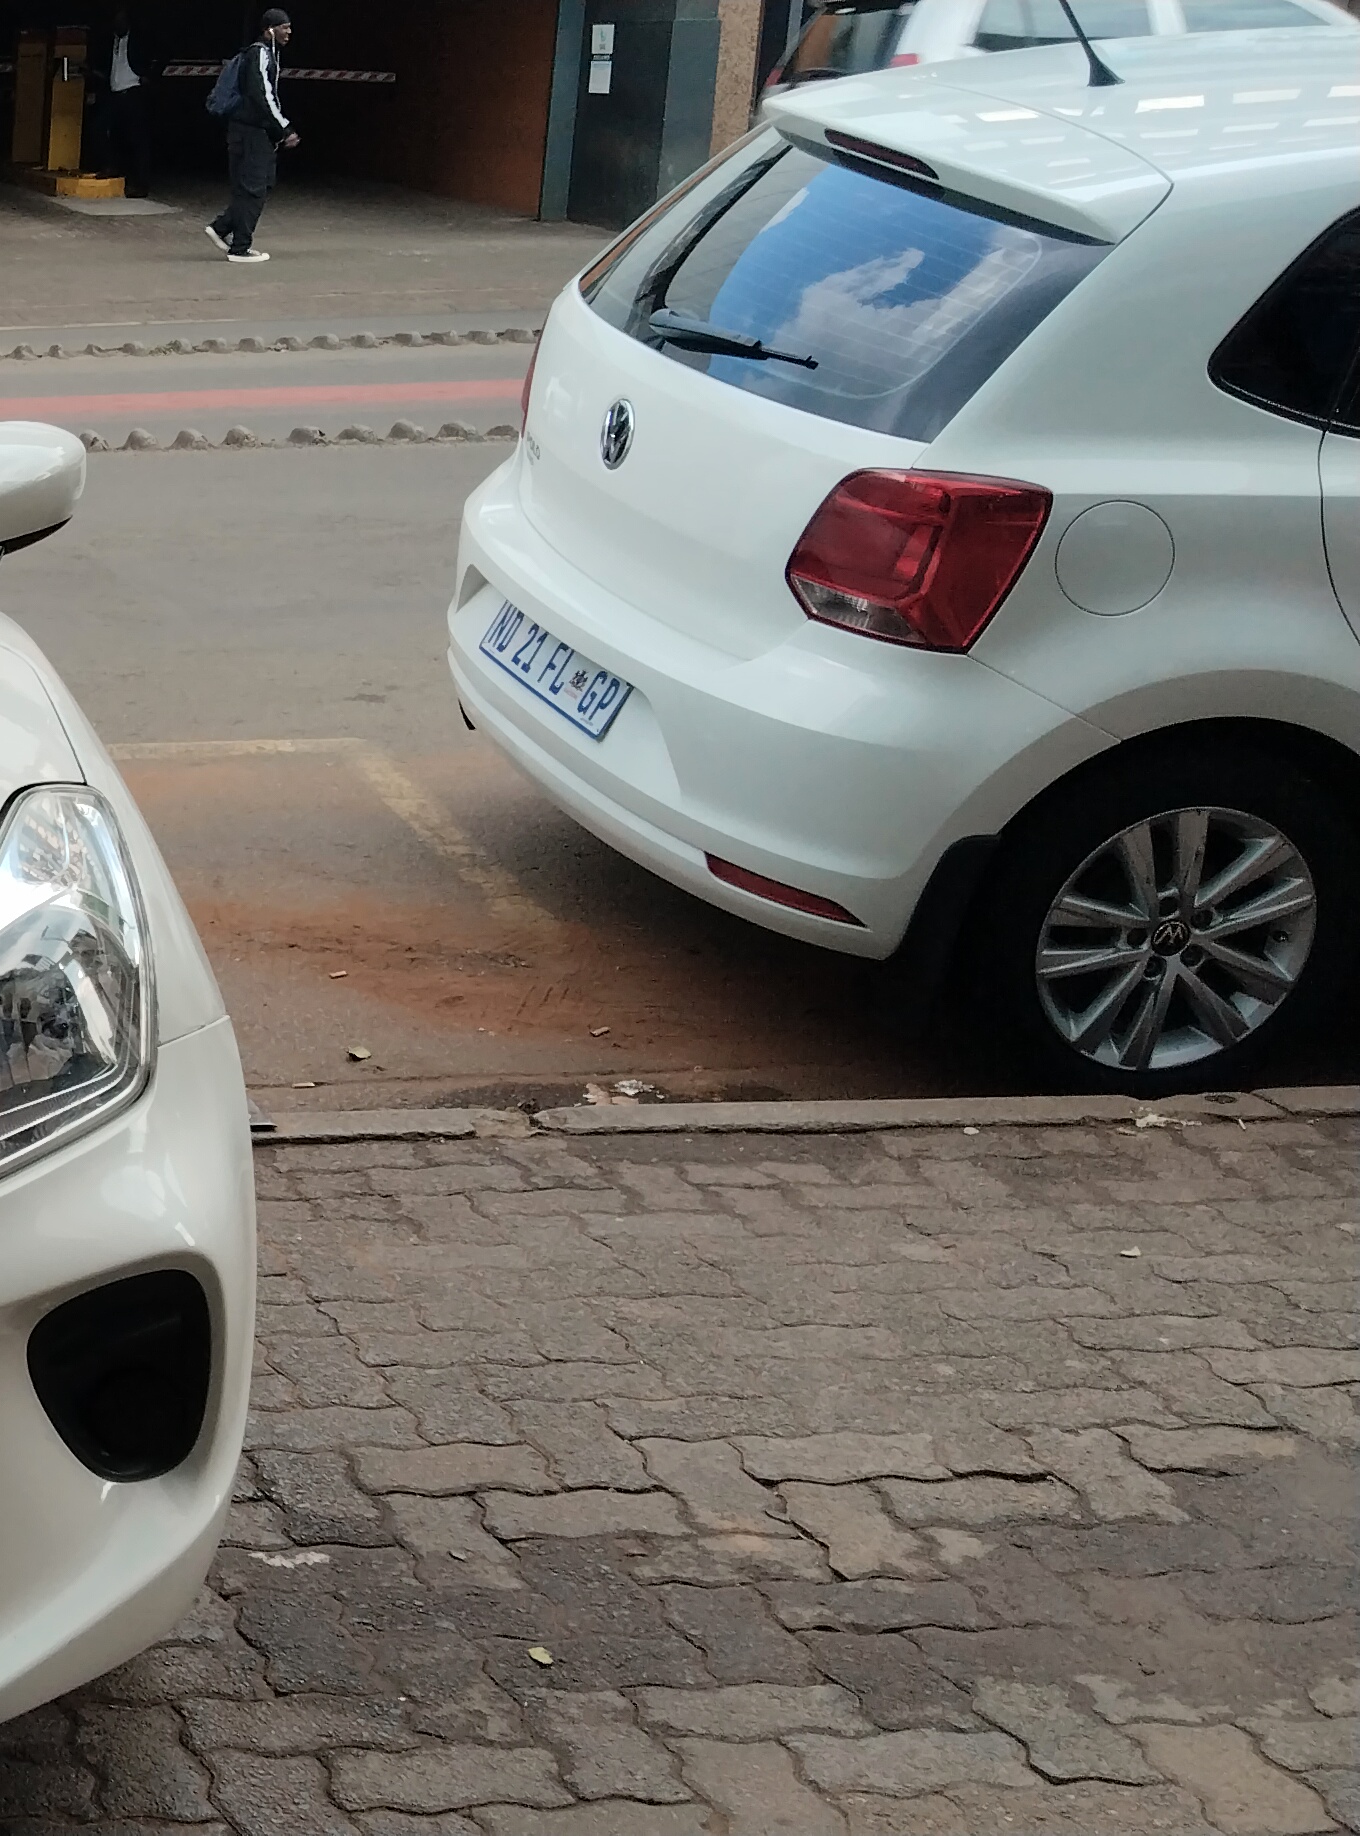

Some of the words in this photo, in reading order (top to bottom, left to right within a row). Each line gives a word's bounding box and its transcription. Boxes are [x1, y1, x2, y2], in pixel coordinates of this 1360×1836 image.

[487, 603, 525, 653] ND
[511, 622, 550, 674] 21
[537, 642, 575, 695] FL
[577, 670, 621, 721] GP
